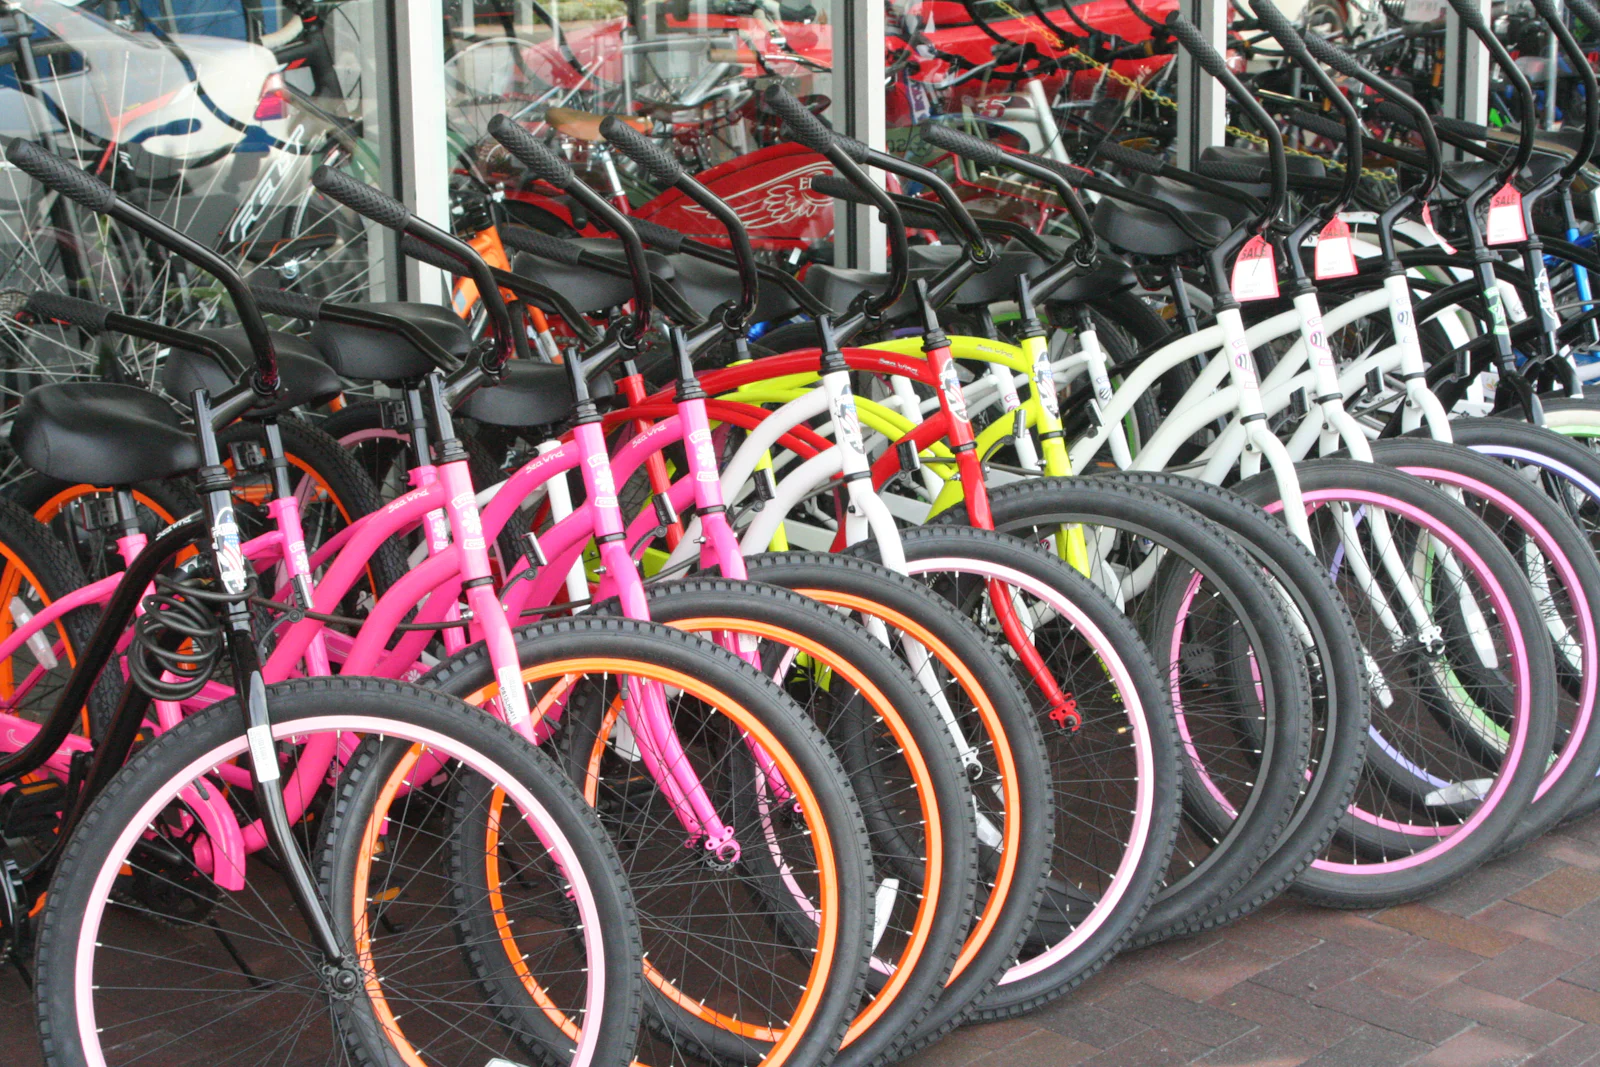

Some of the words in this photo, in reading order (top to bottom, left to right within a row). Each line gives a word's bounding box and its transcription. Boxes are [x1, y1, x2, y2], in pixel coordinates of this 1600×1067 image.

[229, 123, 304, 242] FELT
[1494, 193, 1516, 207] SALE
[1241, 246, 1267, 260] SALE
